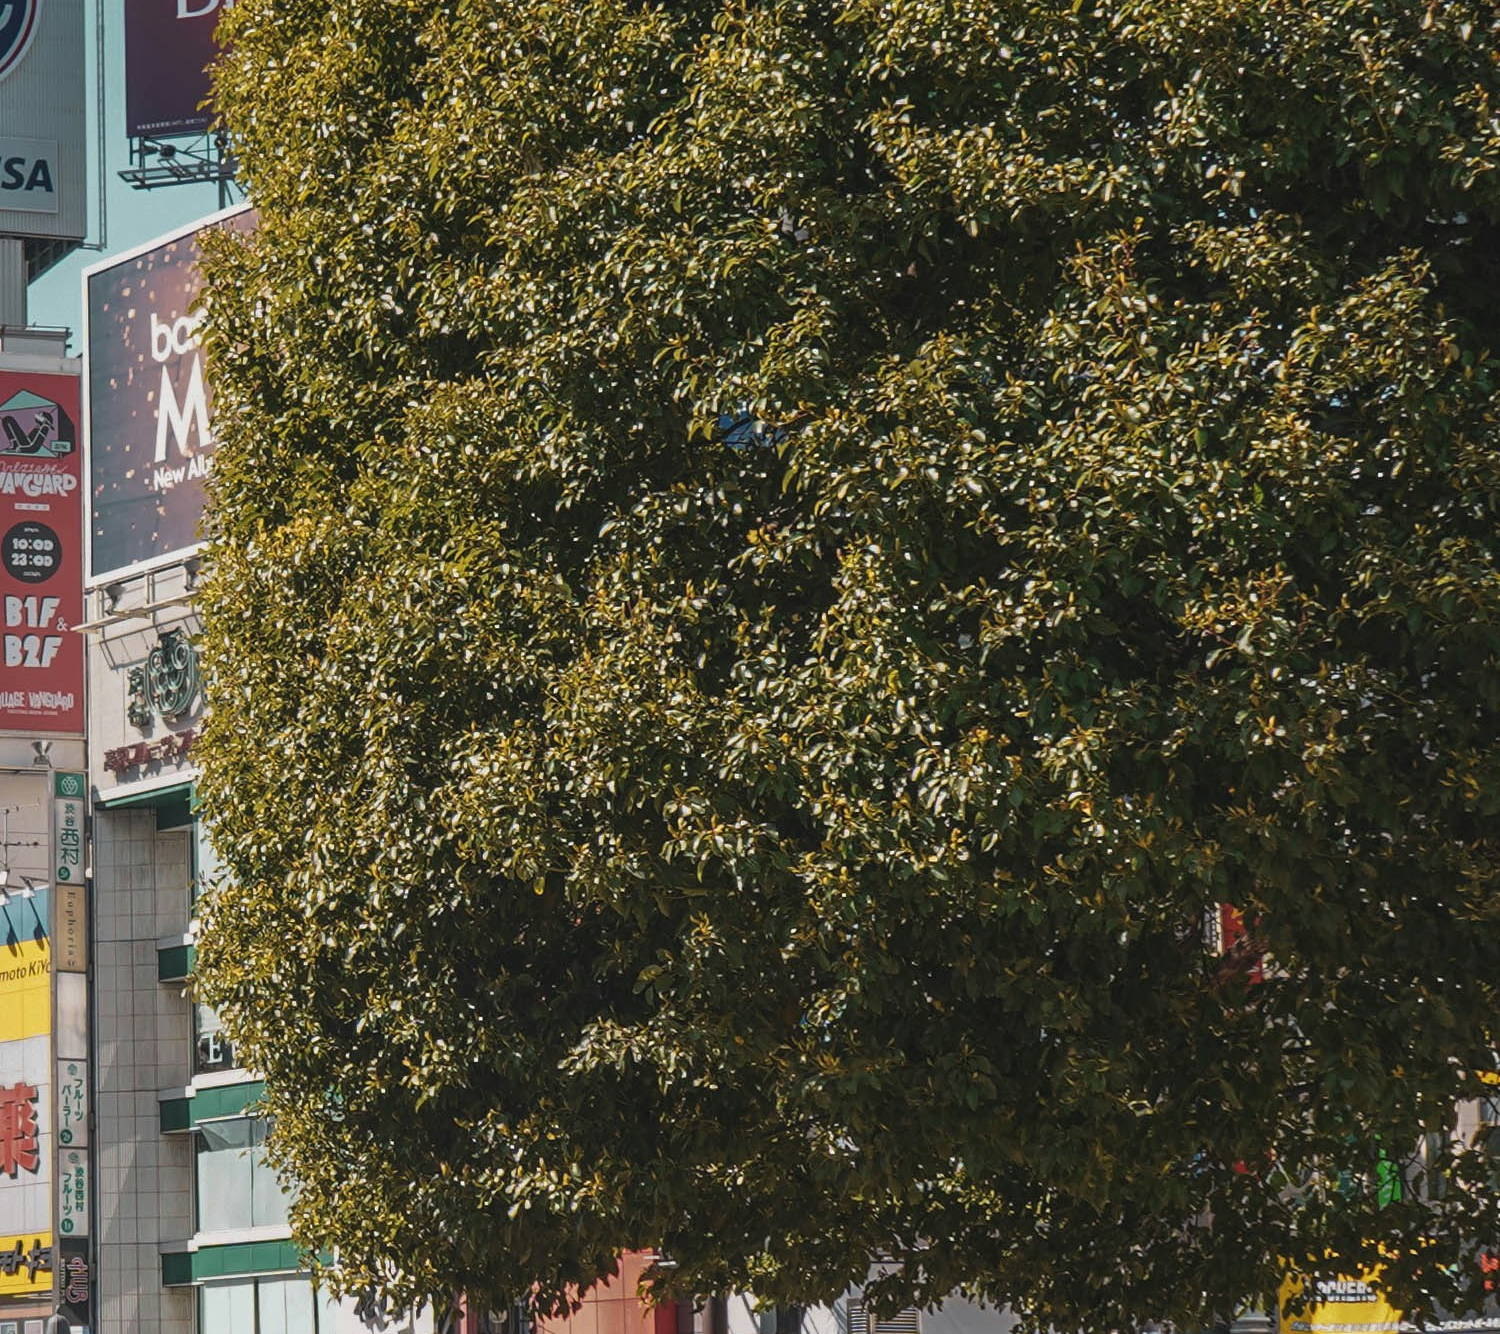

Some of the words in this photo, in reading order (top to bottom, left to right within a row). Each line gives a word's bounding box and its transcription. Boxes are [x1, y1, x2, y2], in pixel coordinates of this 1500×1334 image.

[154, 466, 185, 491] New
[5, 596, 60, 628] B1F
[56, 617, 68, 632] &
[4, 634, 63, 668] B2F
[60, 803, 80, 866] 渋谷西村
[29, 963, 50, 979] KiYo
[73, 1079, 84, 1121] フルーツ
